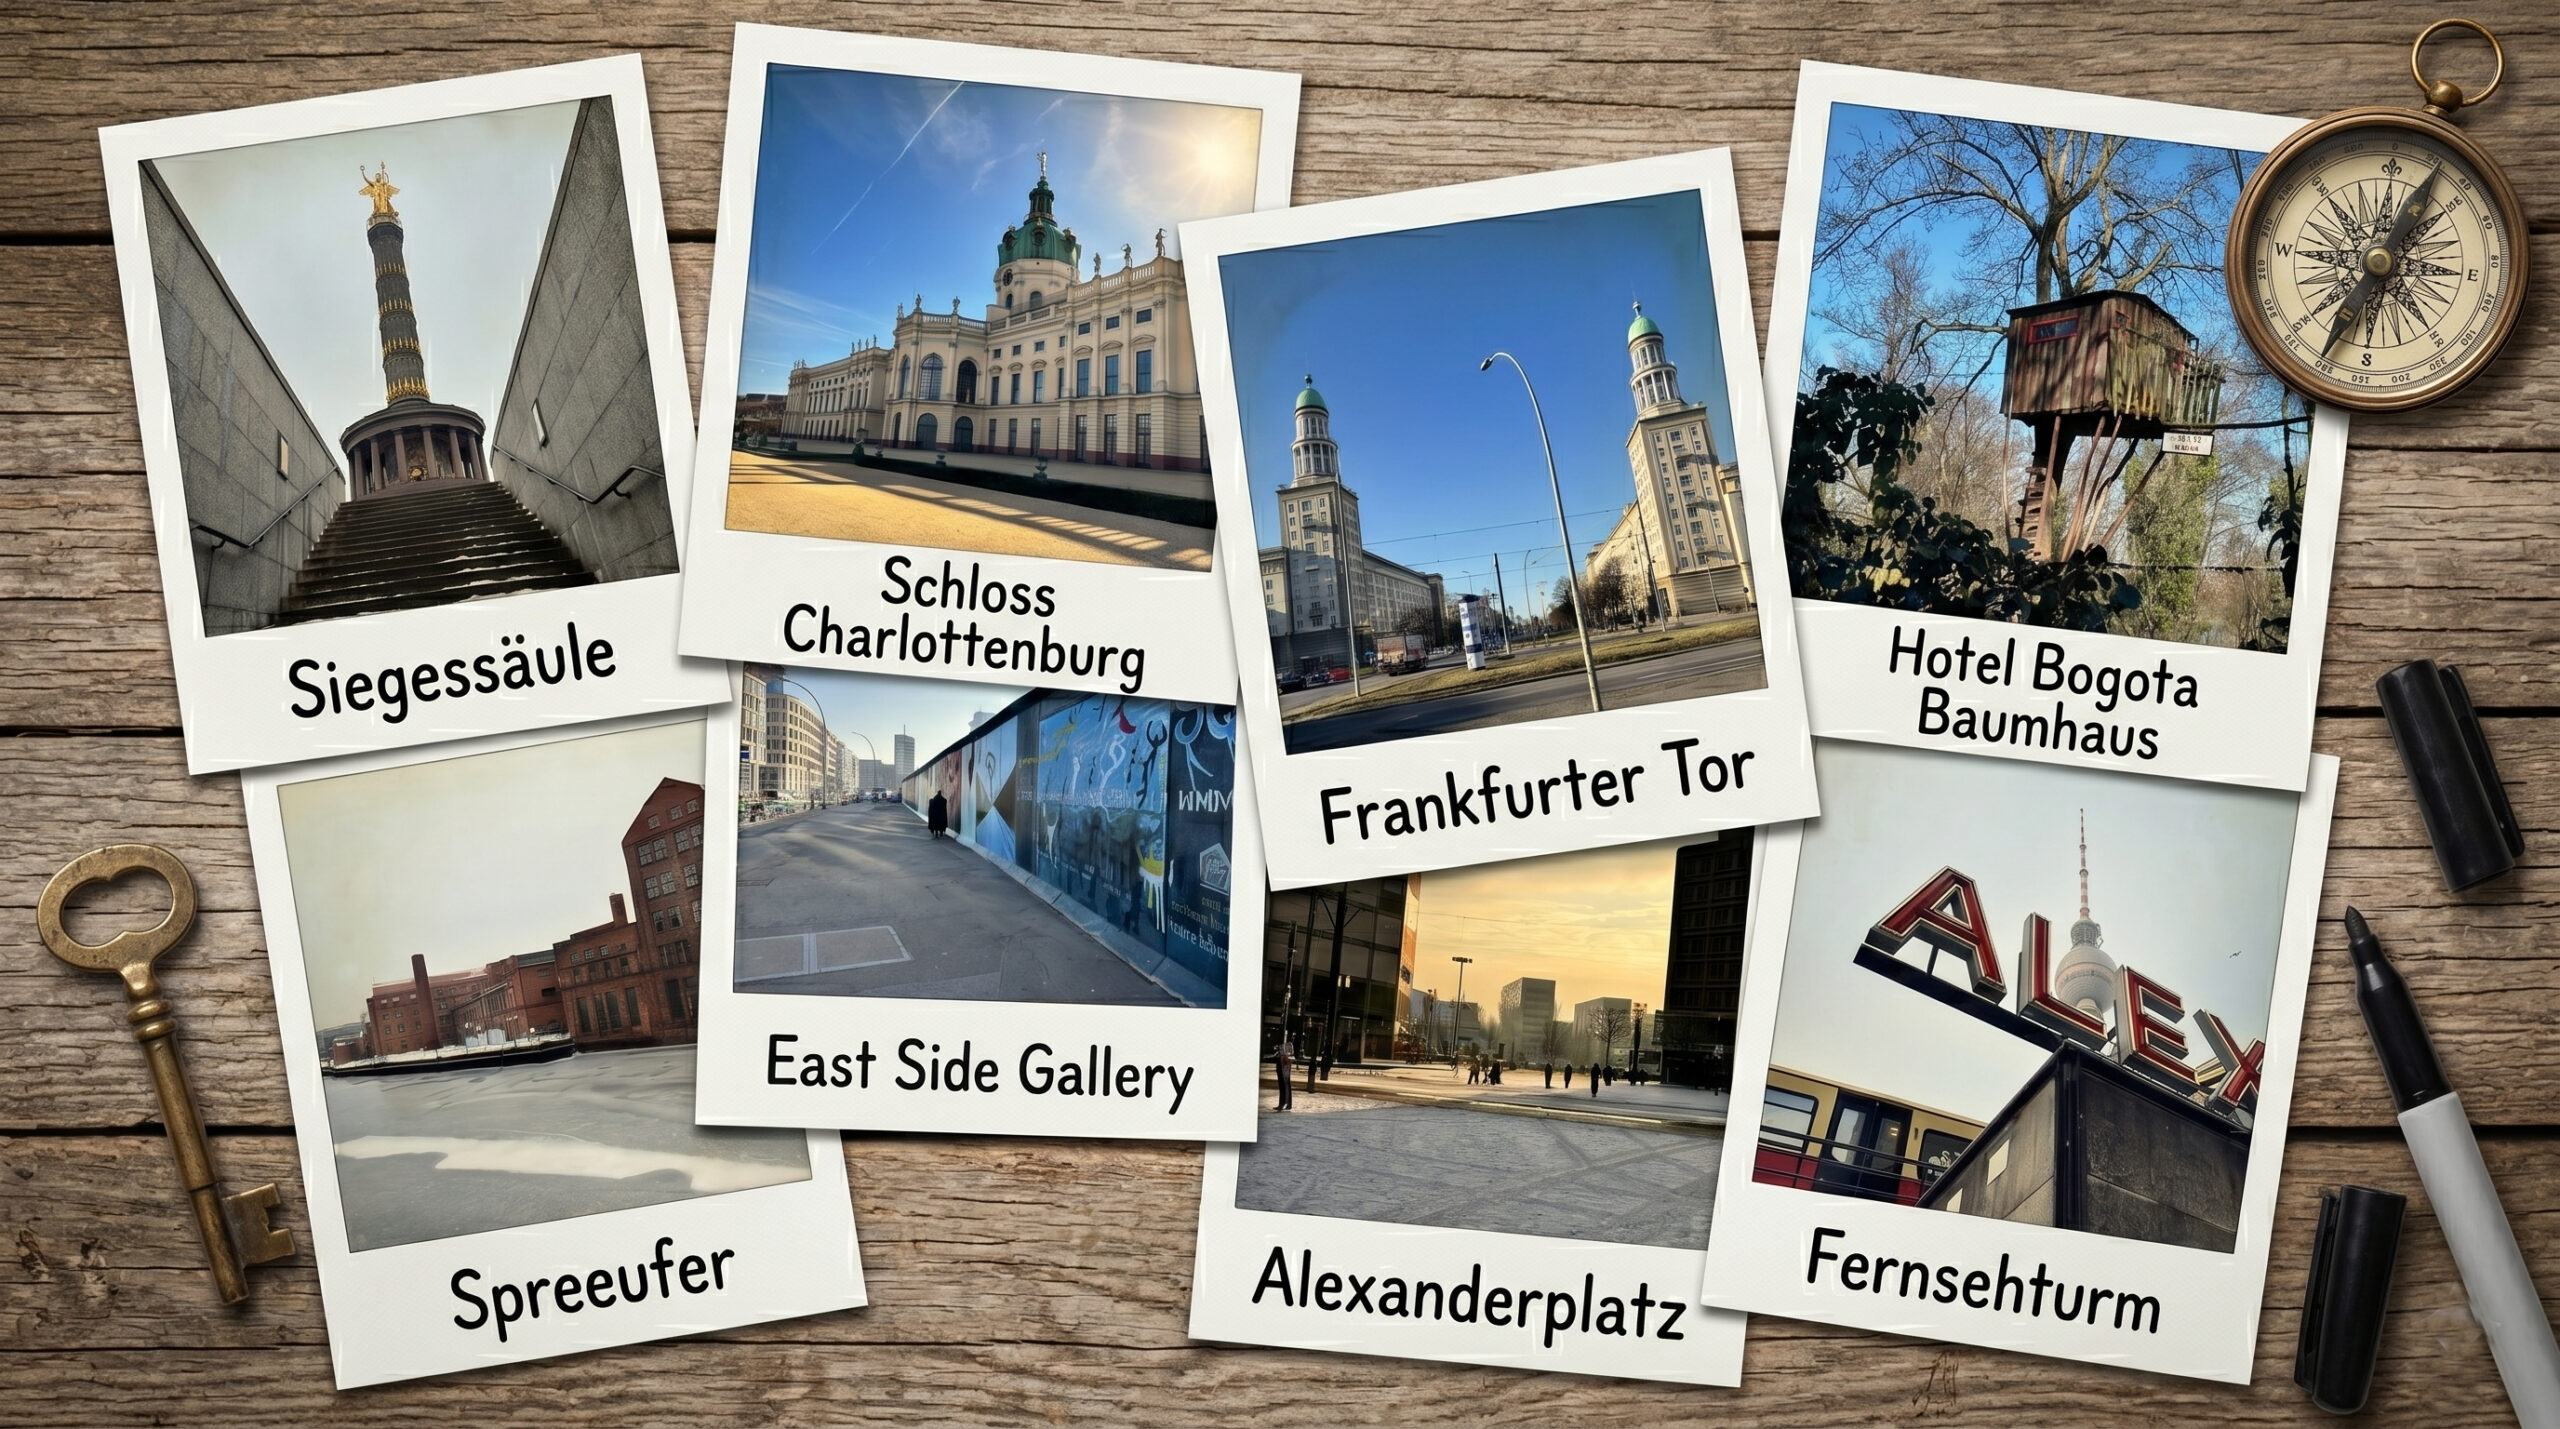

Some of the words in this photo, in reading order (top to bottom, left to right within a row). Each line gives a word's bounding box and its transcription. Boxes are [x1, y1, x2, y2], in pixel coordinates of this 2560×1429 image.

[2275, 242, 2293, 258] W
[2467, 269, 2479, 282] E
[2361, 353, 2372, 367] S
[880, 555, 1056, 618] Schloss
[288, 621, 616, 724] Siegessäule
[783, 604, 1145, 695] Charlottenburg
[1889, 626, 2016, 687] Hotel
[2032, 641, 2199, 713] Bogota
[1918, 686, 2159, 760] Baumhaus
[1320, 758, 1645, 845] Frankfurter
[1660, 737, 1755, 797] Tor
[1865, 866, 2265, 1107] ALEX
[767, 1033, 877, 1089] East
[895, 1037, 999, 1093] Side
[1019, 1042, 1194, 1116] Gallery
[450, 1236, 735, 1343] Spreeufer
[1251, 1246, 1687, 1349] Alexanderplatz
[1807, 1226, 2161, 1334] Fernsehturm
